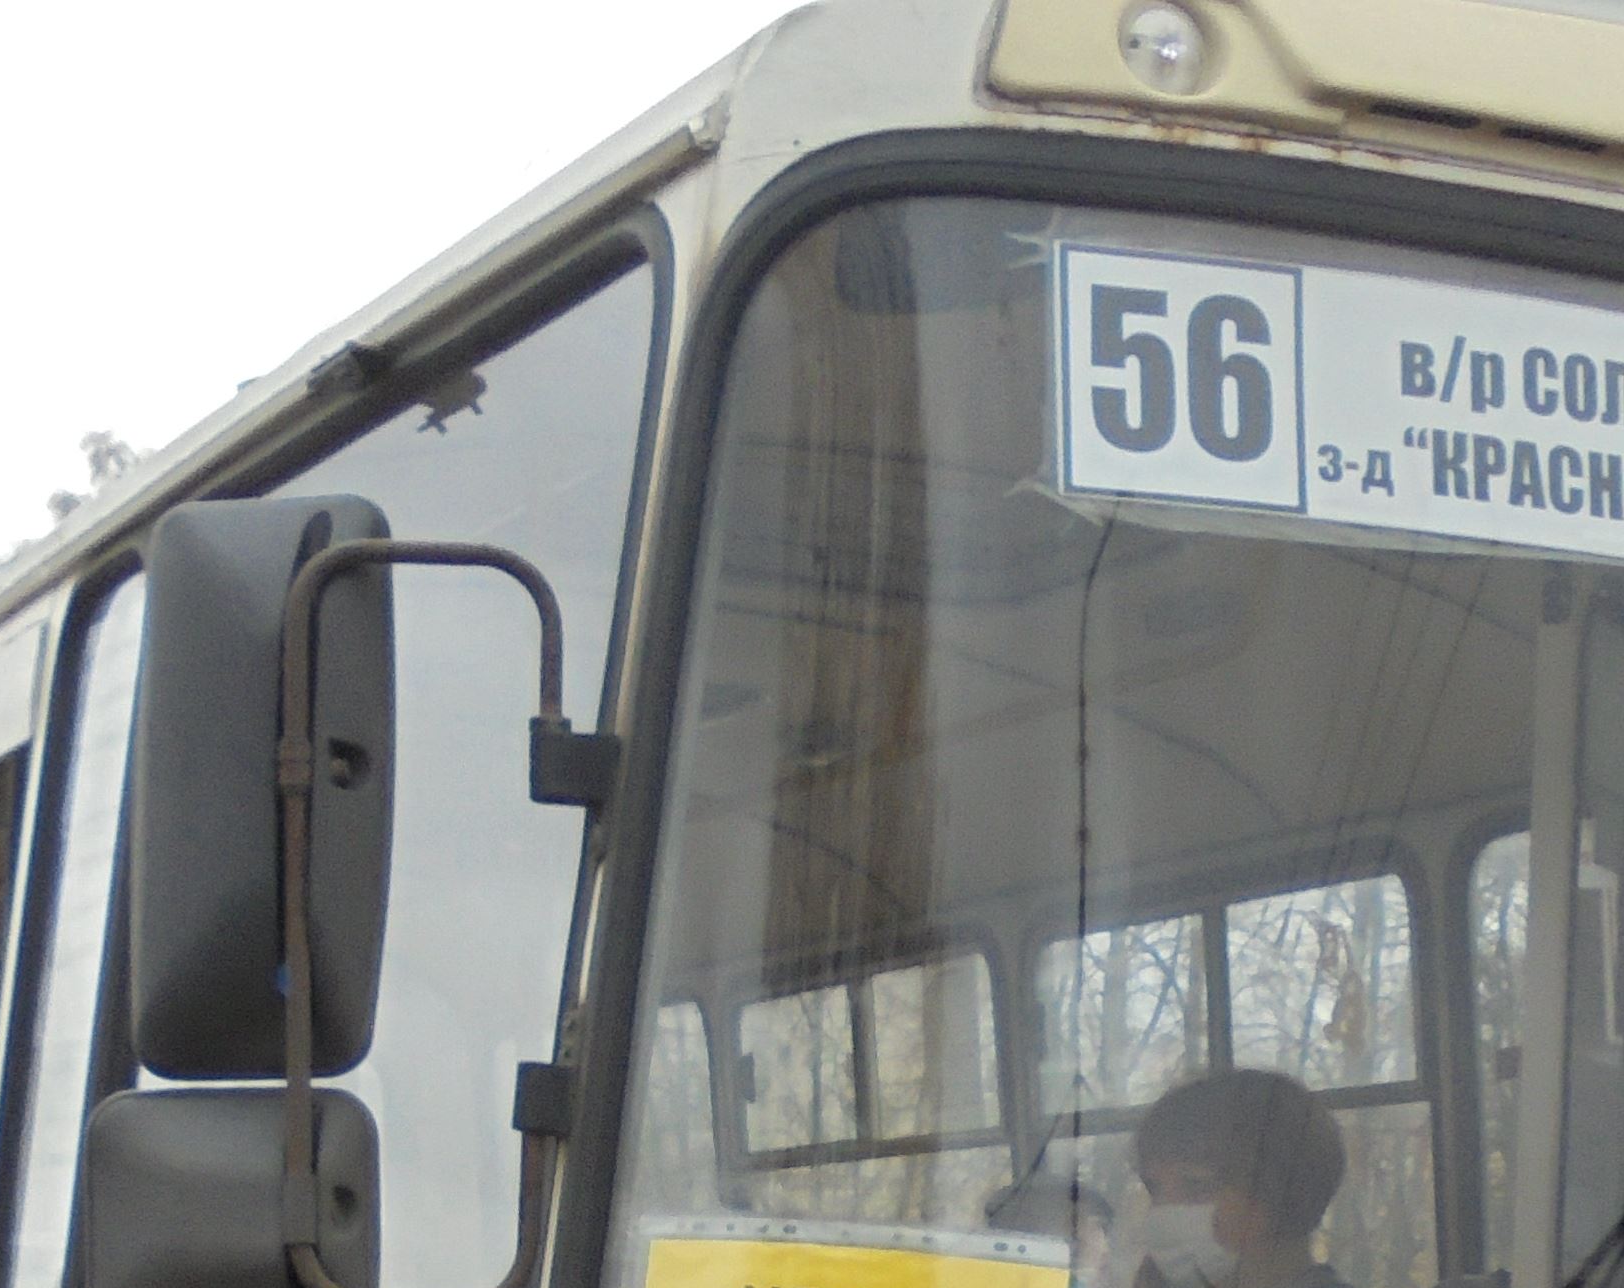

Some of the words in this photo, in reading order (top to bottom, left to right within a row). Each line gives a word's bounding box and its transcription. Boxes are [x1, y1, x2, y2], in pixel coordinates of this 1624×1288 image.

[1090, 283, 1274, 463] 56
[1399, 335, 1506, 413] в/р
[1317, 444, 1395, 496] з-д
